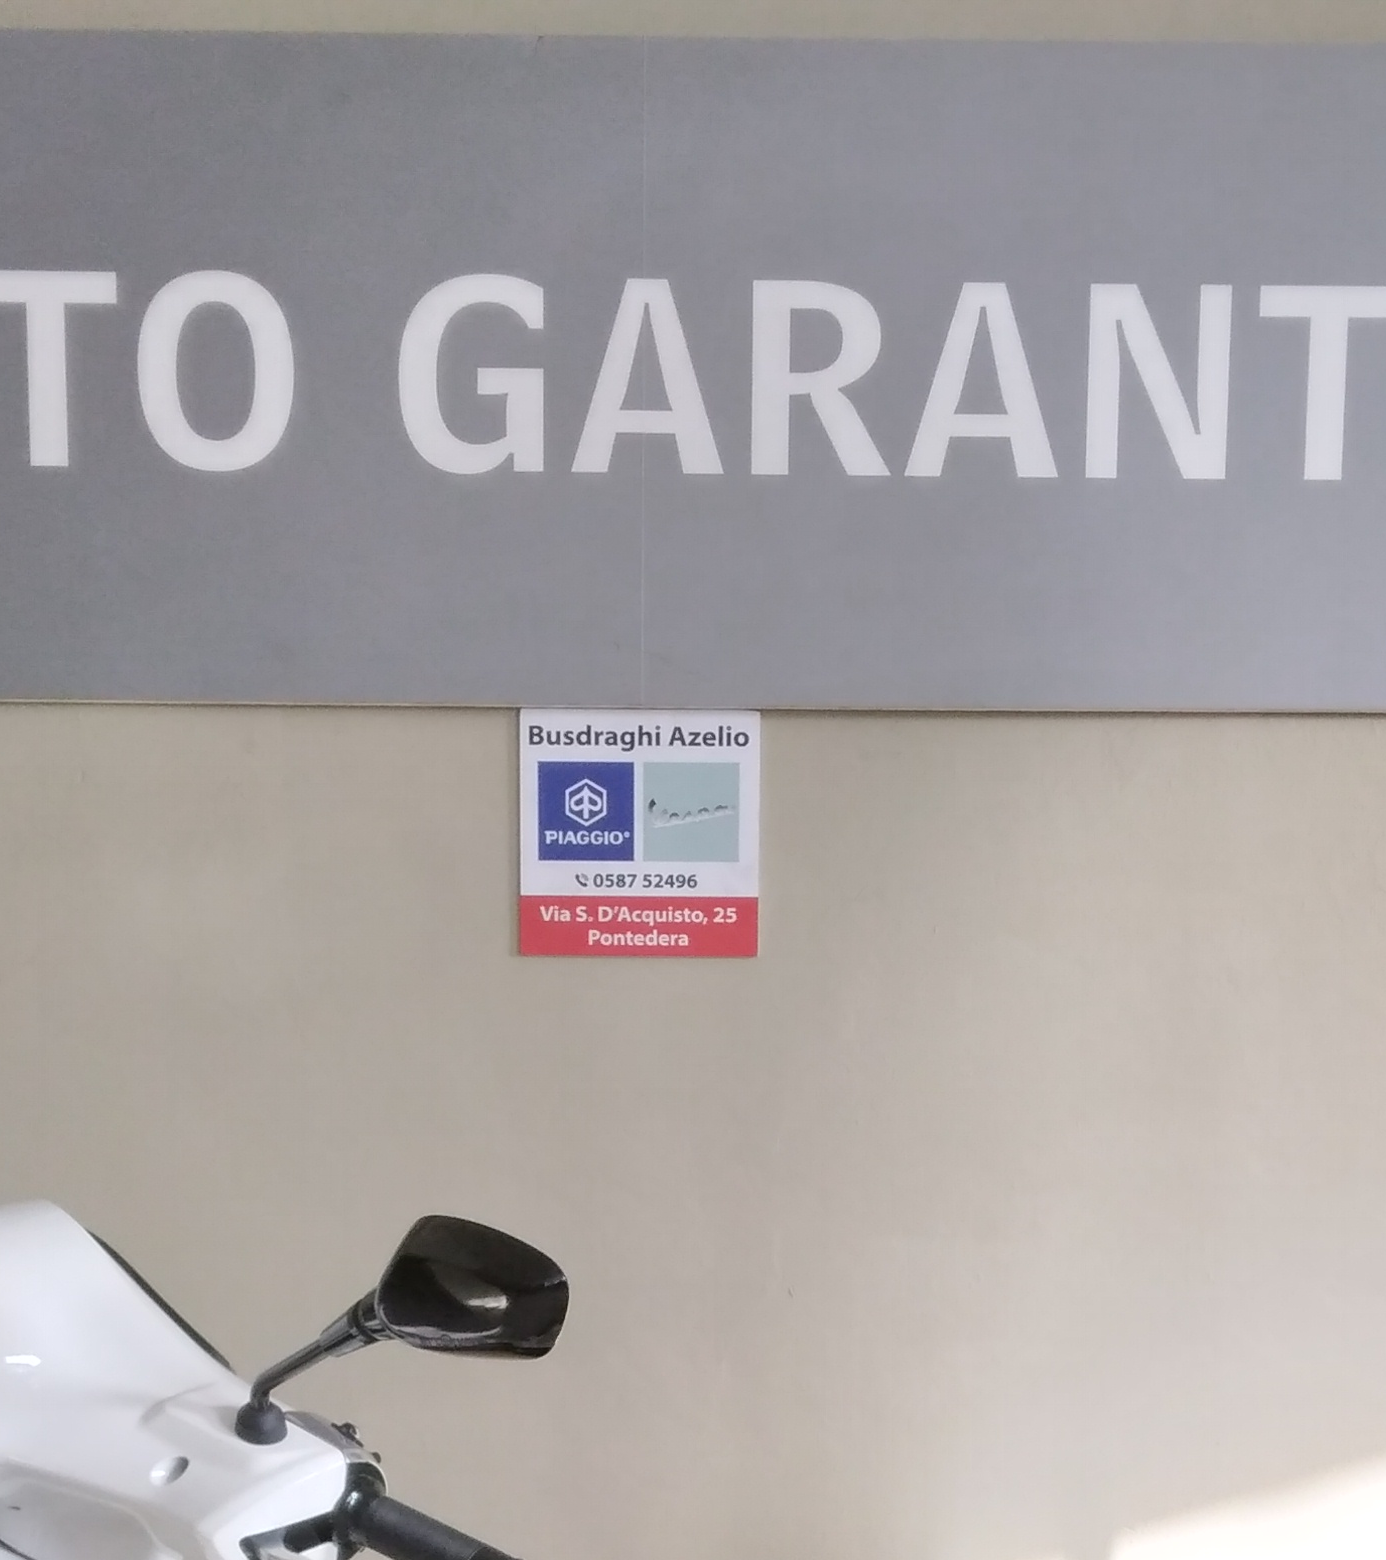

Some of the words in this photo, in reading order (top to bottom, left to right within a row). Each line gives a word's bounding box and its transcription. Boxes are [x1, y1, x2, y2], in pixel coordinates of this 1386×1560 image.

[528, 724, 661, 752] Busdraghi
[668, 725, 750, 748] Azelio
[592, 873, 637, 888] 0587
[642, 873, 698, 889] 52496
[539, 905, 571, 922] Via
[575, 906, 593, 923] S.
[597, 906, 709, 926] D'Acquisto,
[713, 907, 738, 924] 25
[587, 929, 689, 947] Pontedera
